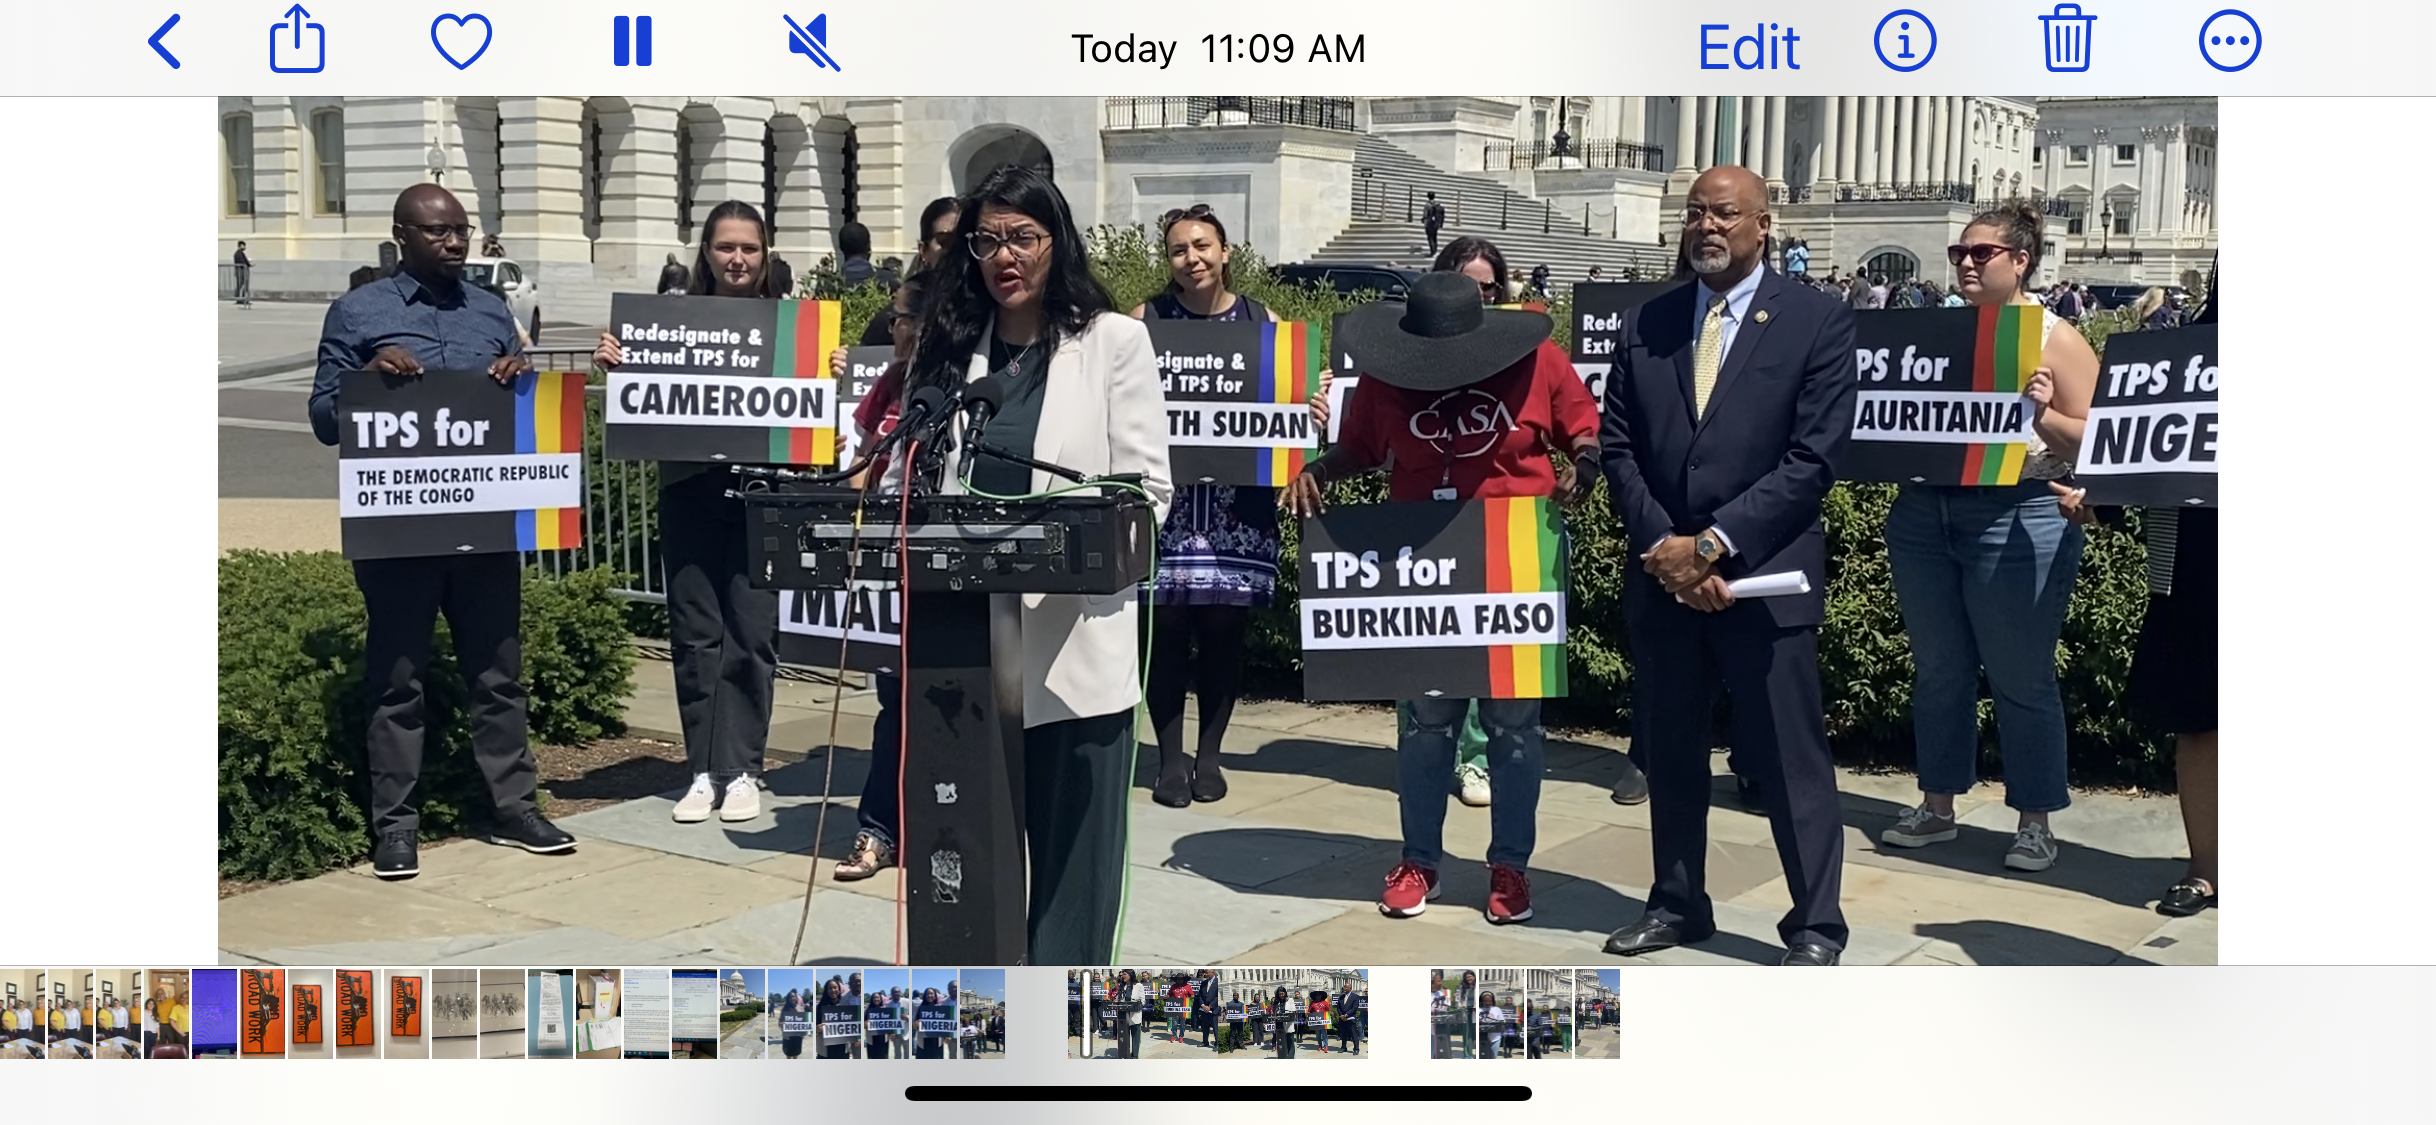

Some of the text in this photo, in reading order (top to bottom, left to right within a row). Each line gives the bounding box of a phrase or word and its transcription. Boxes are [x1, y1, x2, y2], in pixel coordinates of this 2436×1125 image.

[621, 323, 763, 347] Redesignate &
[620, 347, 760, 368] Extend TPS for
[1231, 352, 1245, 370] &
[1901, 345, 1949, 382] for
[1178, 375, 1210, 393] TPS
[1216, 374, 1244, 393] for
[2108, 360, 2172, 397] TPS
[620, 382, 823, 419] CAMEROON
[351, 407, 490, 449] TPS for
[1213, 410, 1308, 439] SUDAN
[1409, 400, 1520, 441] CASA
[357, 464, 569, 486] THE DEMOCRATIC REPUBLIC
[357, 487, 475, 506] OF THE CONGO
[1311, 546, 1457, 590] TPS for
[1312, 602, 1554, 639] BURKINA FASO
[248, 1010, 261, 1044] WORK
[824, 1012, 853, 1021] TPS for
[869, 1020, 903, 1029] NIGERIA
